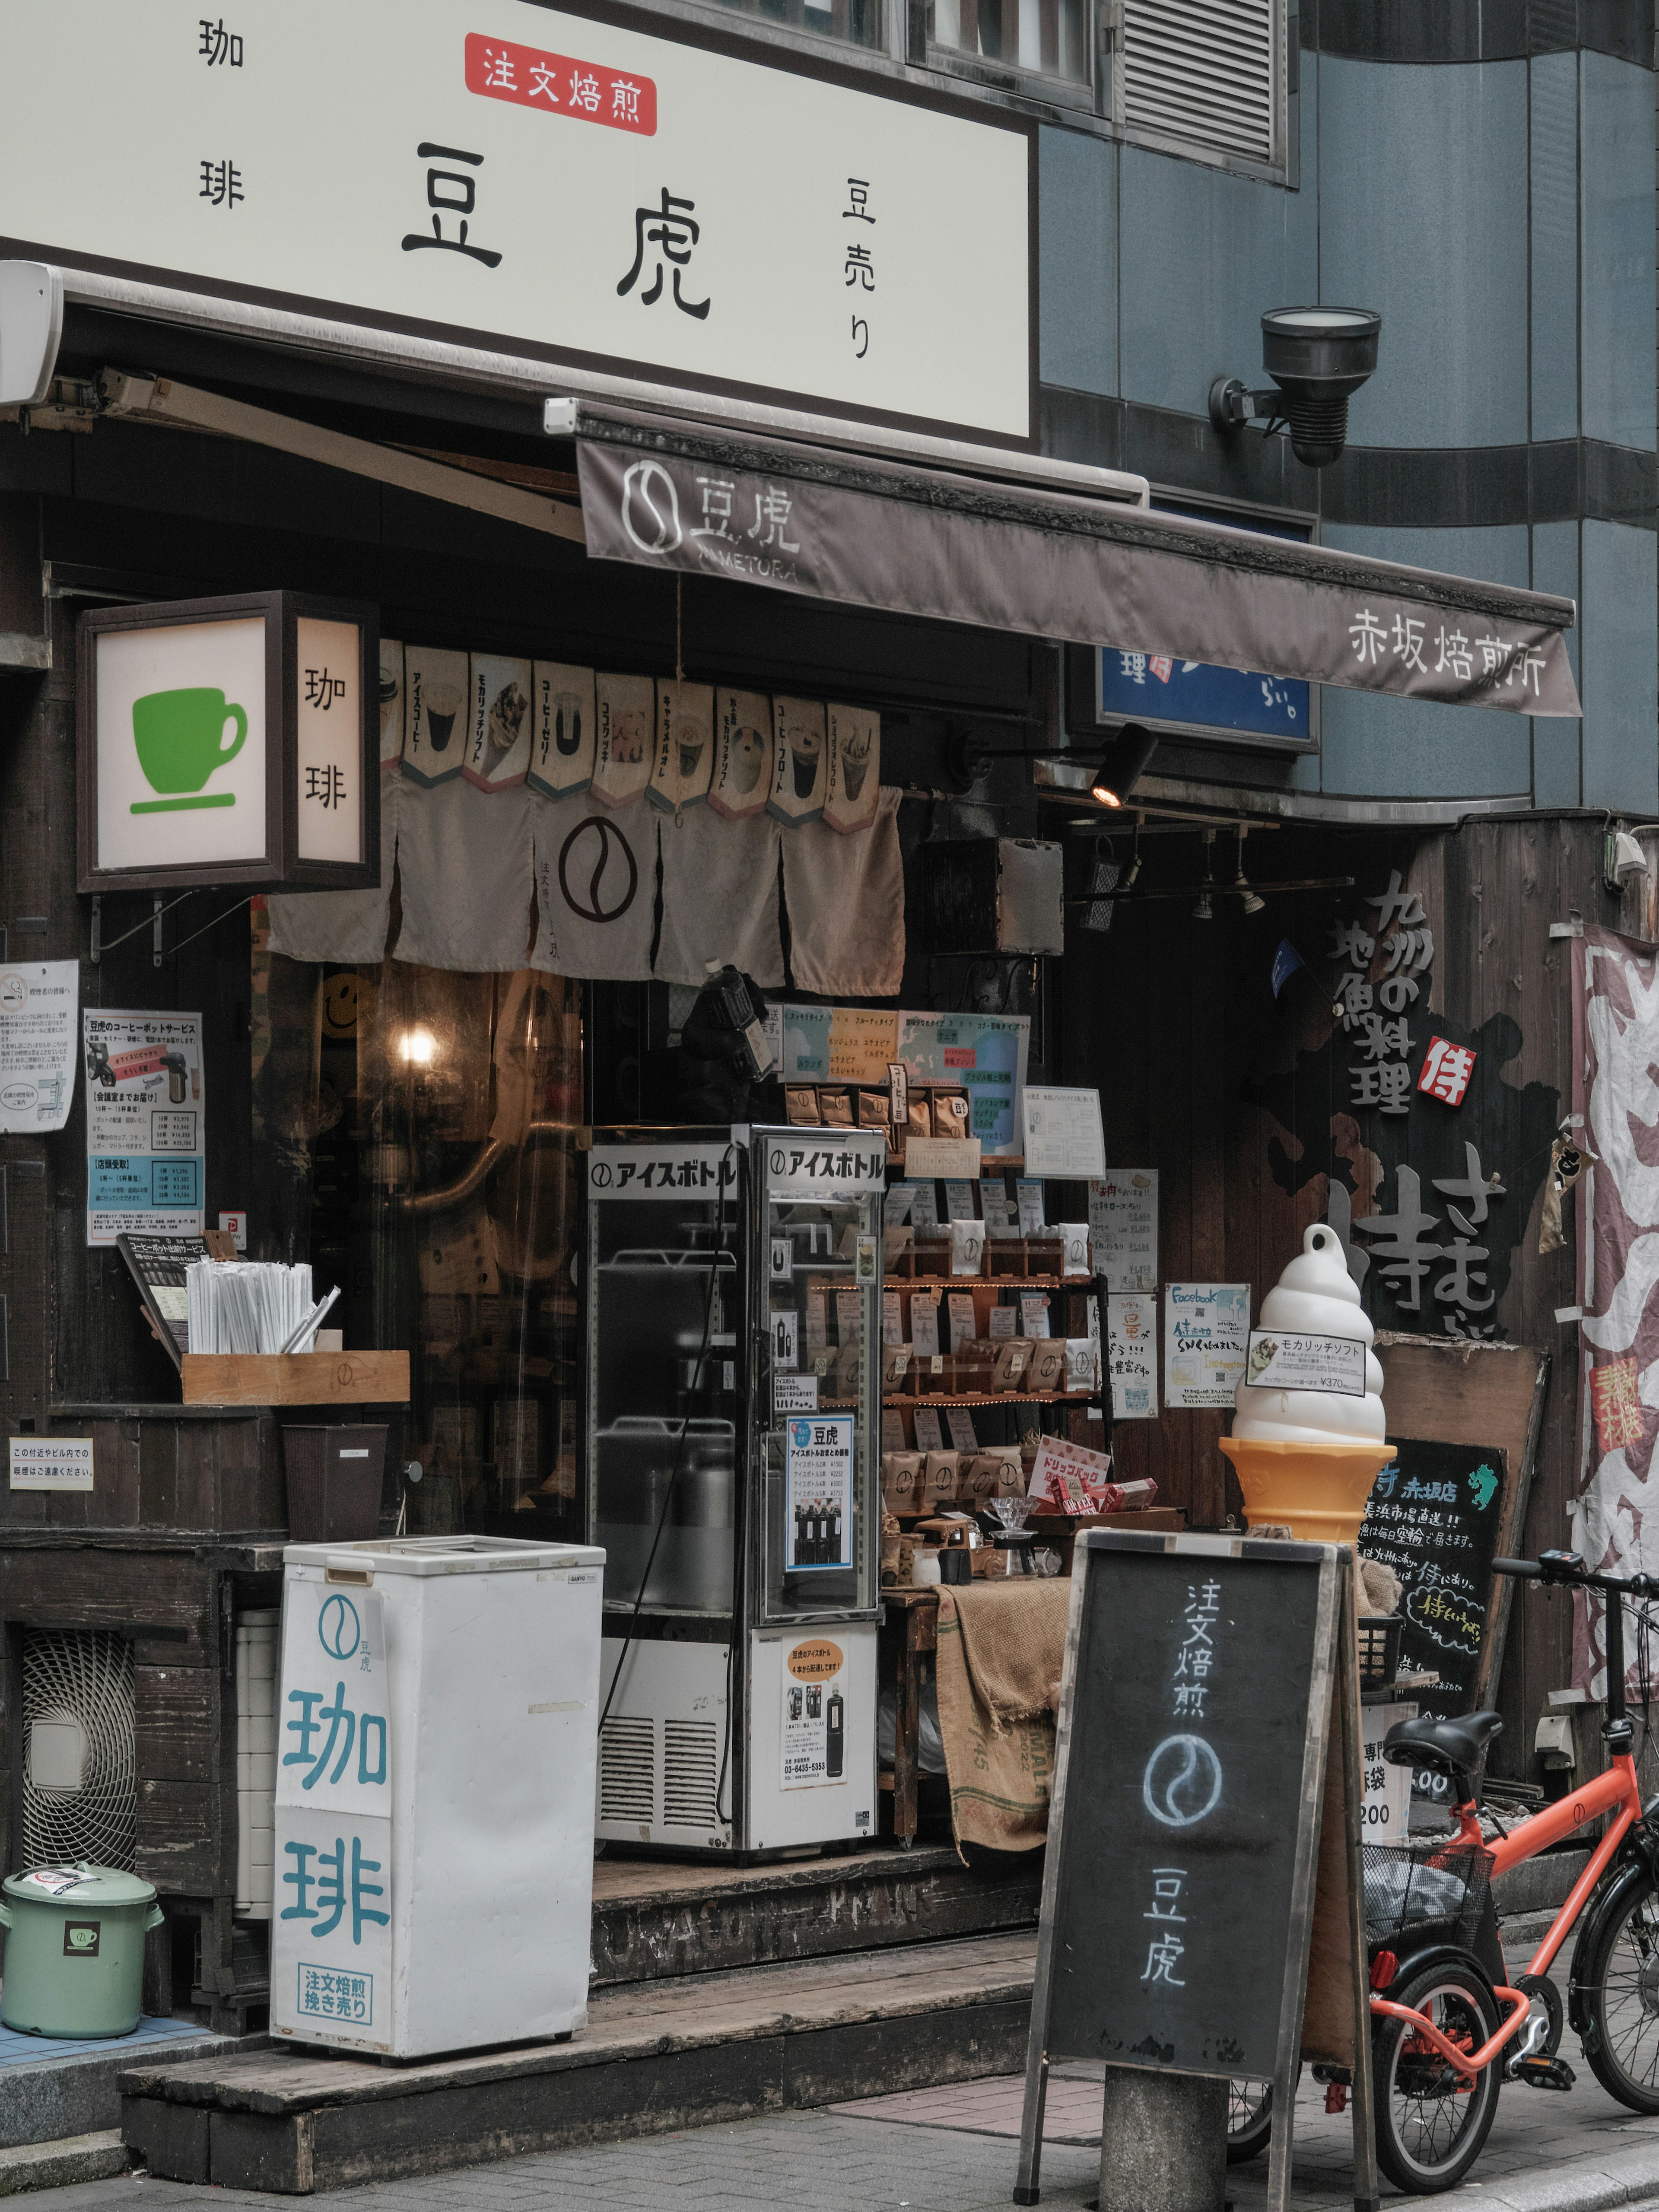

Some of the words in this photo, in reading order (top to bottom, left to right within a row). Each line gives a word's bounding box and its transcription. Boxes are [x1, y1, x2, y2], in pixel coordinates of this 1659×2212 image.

[483, 49, 642, 124] 注文焙煎
[199, 19, 245, 209] 珈琲
[401, 142, 711, 320] 豆虎
[842, 178, 876, 358] 豆売り
[691, 477, 800, 553] 豆虎
[1349, 608, 1546, 697] 赤坂焙煎所
[305, 667, 346, 809] 珈琲
[542, 680, 550, 765] コーヒーゼリー
[1364, 869, 1434, 1013] 九州の
[30, 987, 70, 995] 喫煙者の皆様へ
[90, 1021, 195, 1033] 豆虎のコーヒーポットサービス
[1326, 918, 1416, 1114] 地魚料理
[1418, 1041, 1474, 1106] 侍
[894, 1068, 903, 1120] コーヒー豆
[617, 1160, 736, 1187] アイスボトル
[788, 1150, 884, 1179] アイスボトル
[1172, 1286, 1217, 1304] Facebook
[1282, 1340, 1359, 1357] モカリッチソフト
[1320, 1378, 1343, 1388] ¥370
[814, 1426, 838, 1445] 豆虎
[14, 1449, 88, 1458] この付近やビル内での
[791, 1449, 849, 1457] アイスボトルおまとめ価格
[14, 1466, 92, 1477] 喫煙はご遠慮ください。
[360, 1641, 371, 1672] 豆虎
[792, 1649, 830, 1659] 豆虎のアイスボトル
[1173, 1578, 1221, 1717] 注文焙煎
[785, 1762, 825, 1774] 03-6435-5353
[281, 1681, 390, 1945] 珈琲
[1140, 1867, 1188, 1986] 豆虎
[305, 1970, 366, 1998] 注文焙煎
[305, 1991, 366, 2018] 挽き売り
